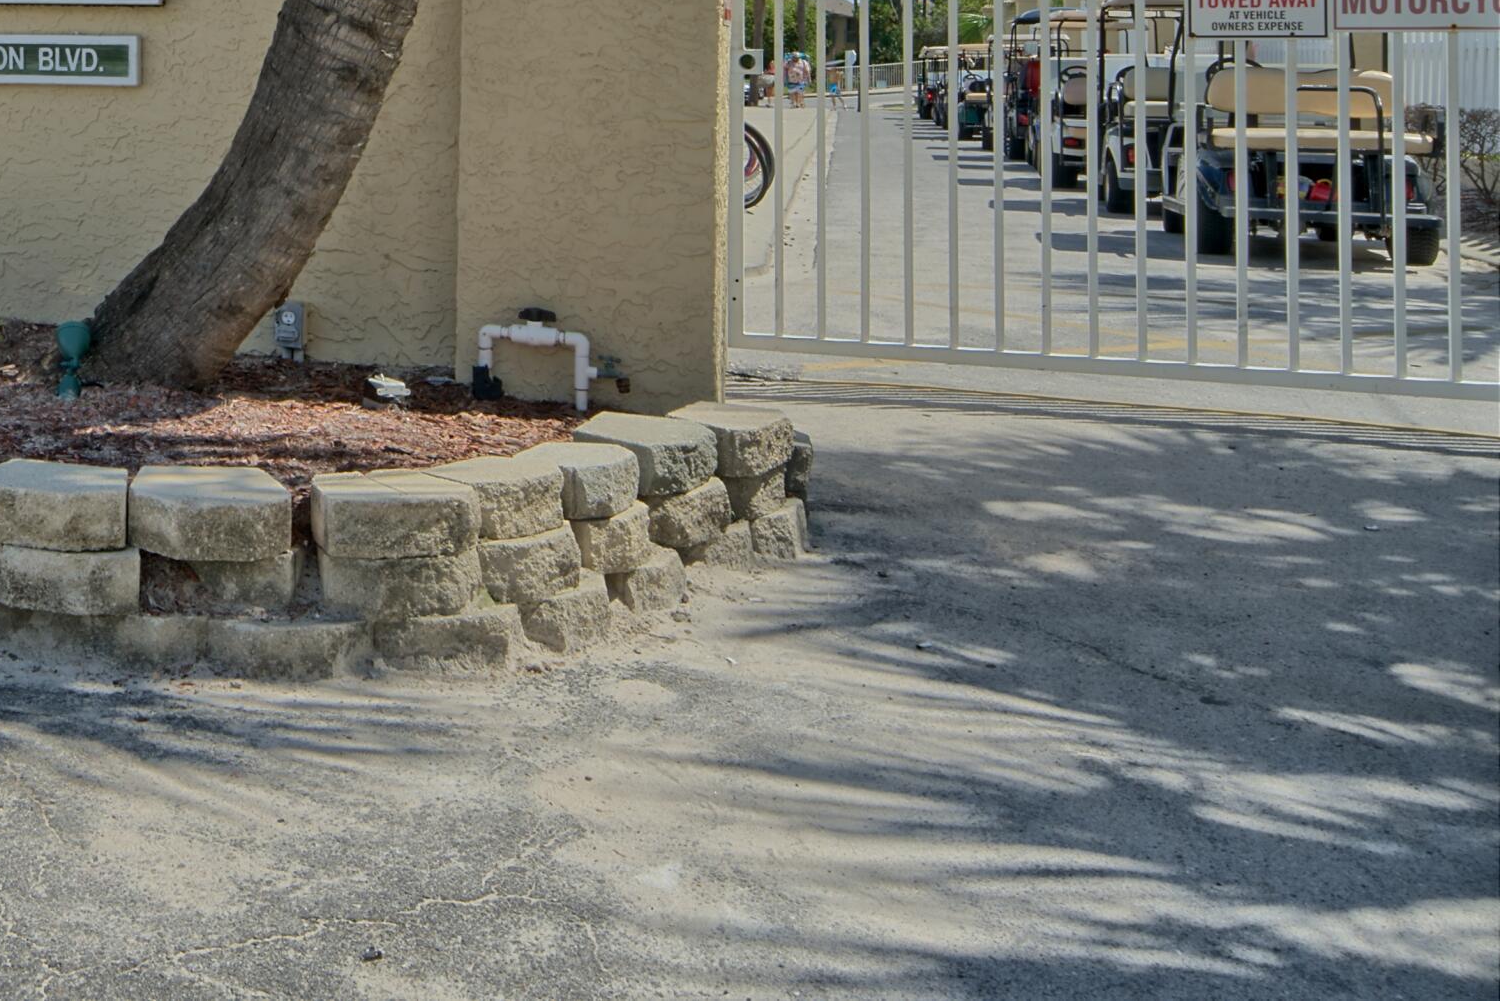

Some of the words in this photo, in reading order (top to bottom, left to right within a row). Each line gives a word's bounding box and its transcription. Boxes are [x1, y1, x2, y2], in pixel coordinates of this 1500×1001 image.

[1228, 11, 1240, 20] AT
[1243, 10, 1286, 20] VEHICLE
[1211, 22, 1254, 31] OWNERS
[1257, 21, 1304, 31] EXPENSE
[38, 47, 104, 72] BLVD.
